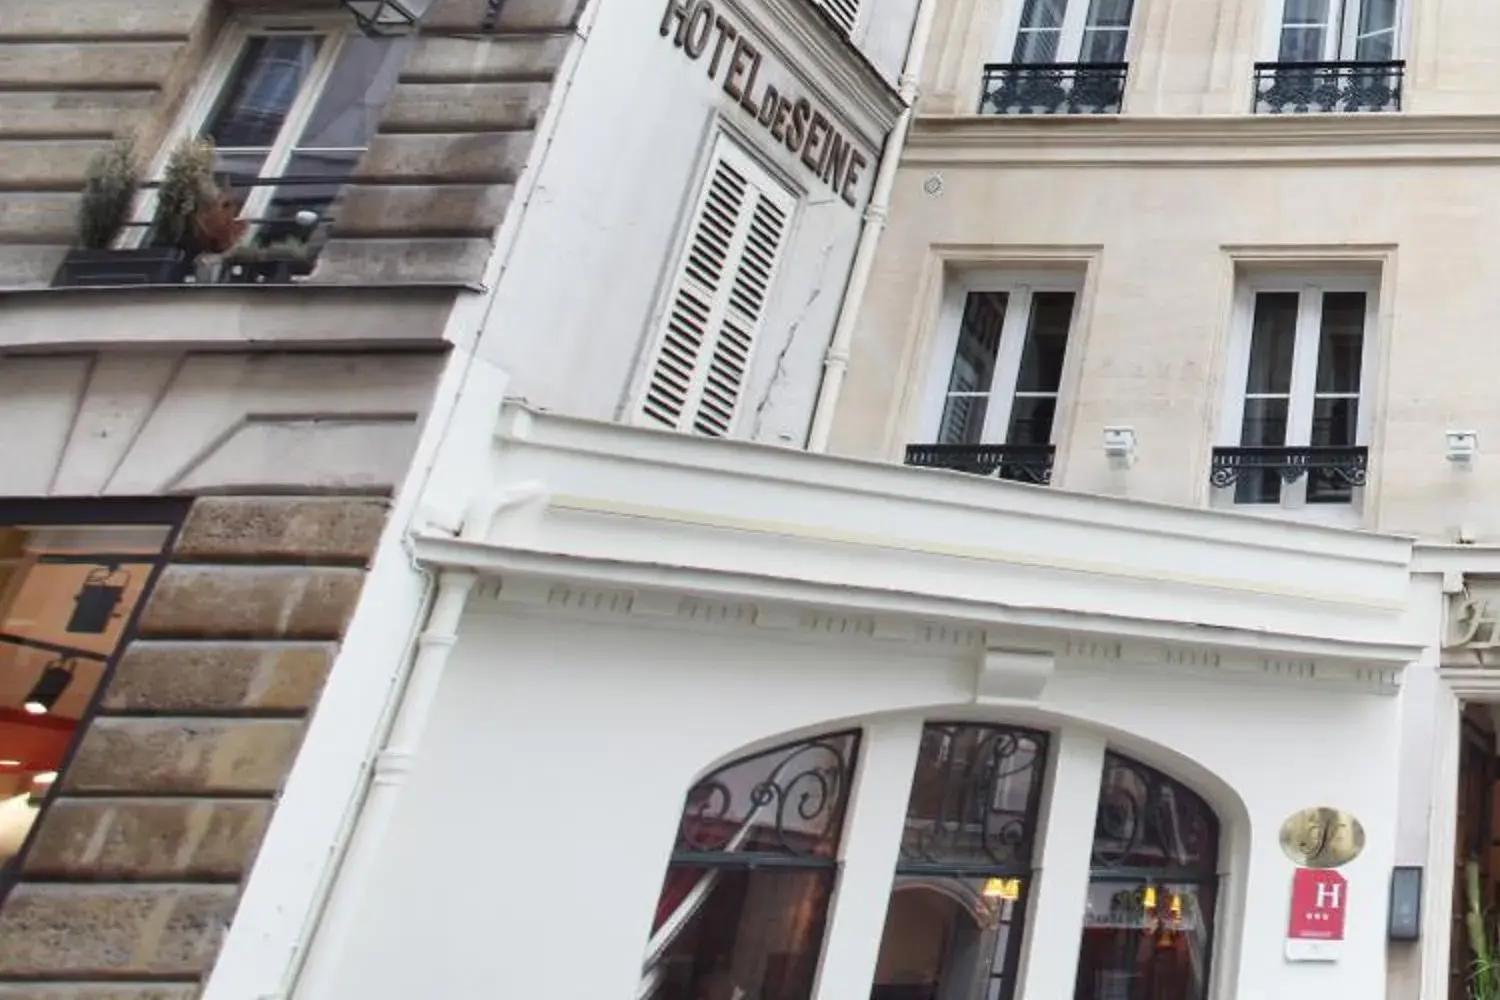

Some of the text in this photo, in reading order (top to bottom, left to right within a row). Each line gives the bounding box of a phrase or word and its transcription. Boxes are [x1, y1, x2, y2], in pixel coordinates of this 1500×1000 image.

[757, 84, 792, 144] DE
[785, 96, 867, 208] SEINE
[1315, 882, 1341, 910] H
